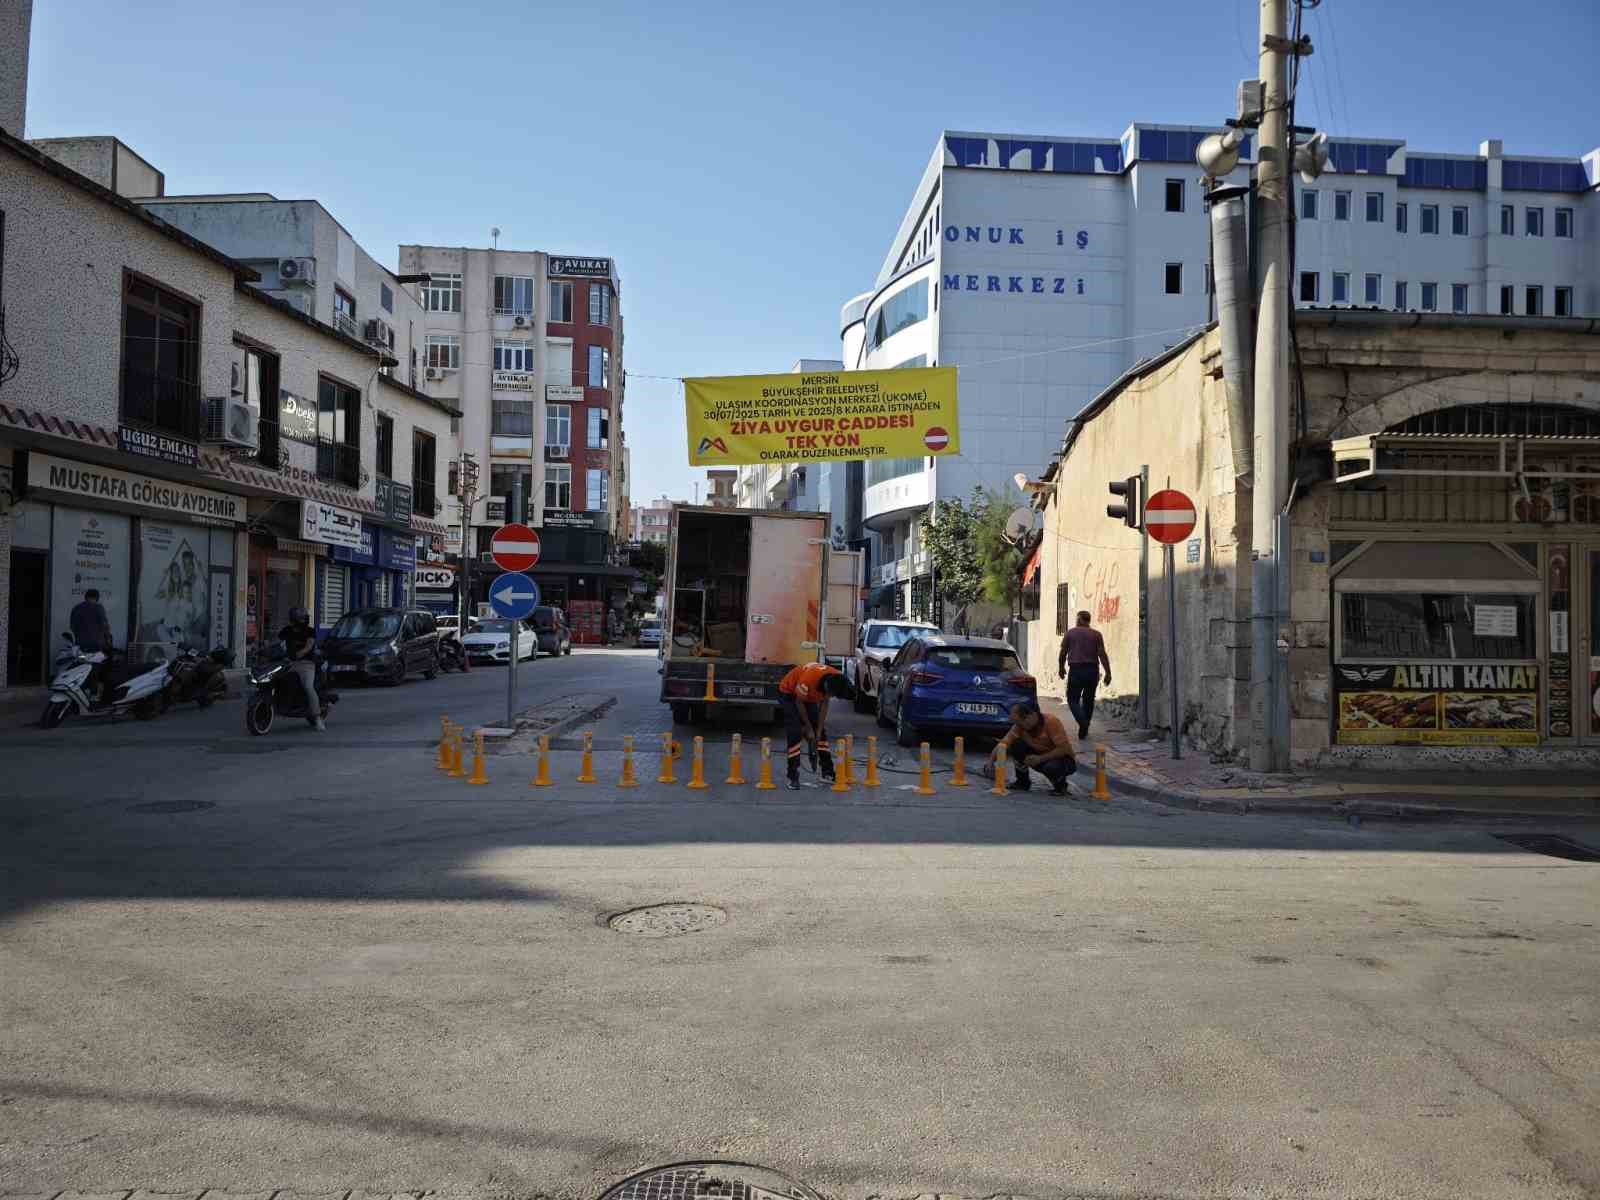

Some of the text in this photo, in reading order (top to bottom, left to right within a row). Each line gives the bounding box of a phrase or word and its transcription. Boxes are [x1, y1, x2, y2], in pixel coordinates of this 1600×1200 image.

[945, 225, 1024, 245] ONUK
[793, 407, 805, 416] VE
[845, 404, 886, 414] KARARA
[774, 418, 834, 433] UYGUR
[785, 431, 860, 449] TEK YÖN
[760, 450, 800, 460] OLARAK
[49, 465, 236, 518] MUSTAFA GÖKSU AYDEMİR
[1392, 665, 1538, 689] ALTIN KANAT
